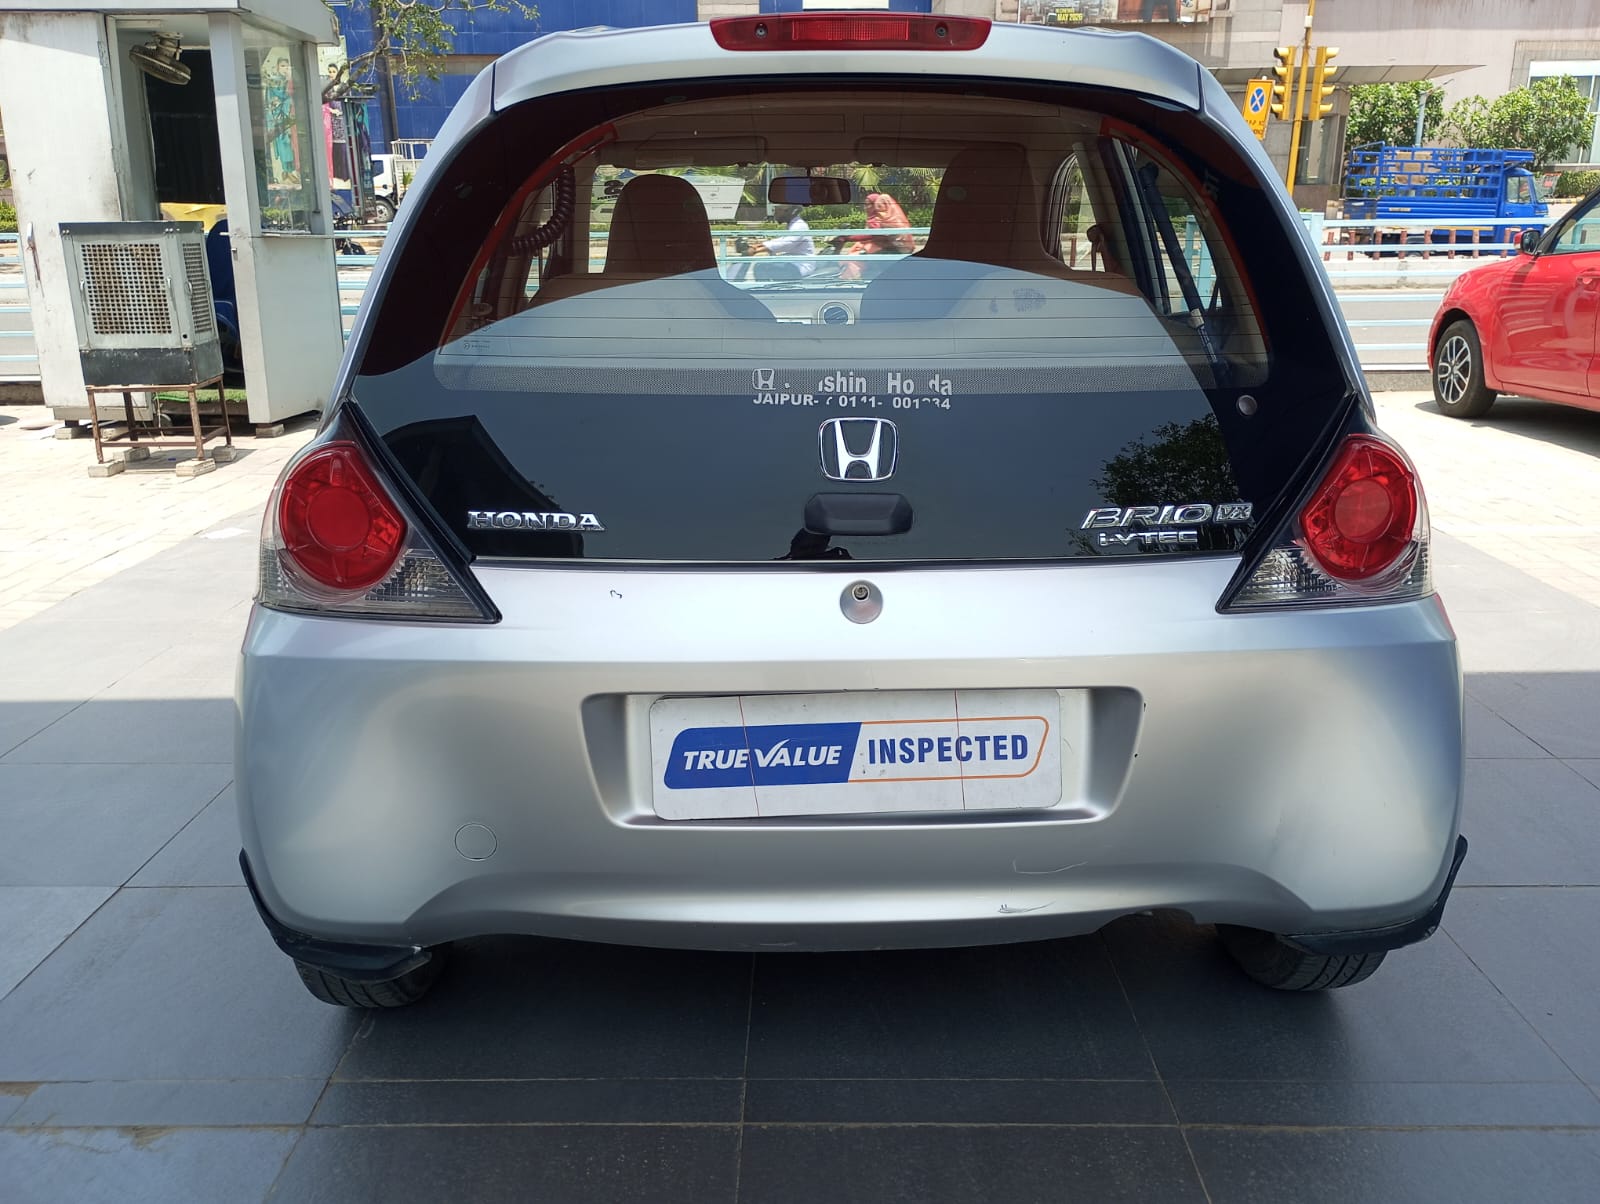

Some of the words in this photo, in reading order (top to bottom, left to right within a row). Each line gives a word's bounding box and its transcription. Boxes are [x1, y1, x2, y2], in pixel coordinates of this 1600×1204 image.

[753, 393, 819, 406] JAIPUR-
[467, 511, 605, 531] HONDA
[1080, 503, 1213, 529] BRIO
[1217, 503, 1252, 520] VX
[1098, 530, 1198, 547] i-VTEC
[682, 748, 750, 771] TRUE
[753, 738, 842, 768] VALUE
[867, 734, 1029, 765] INSPECTED
